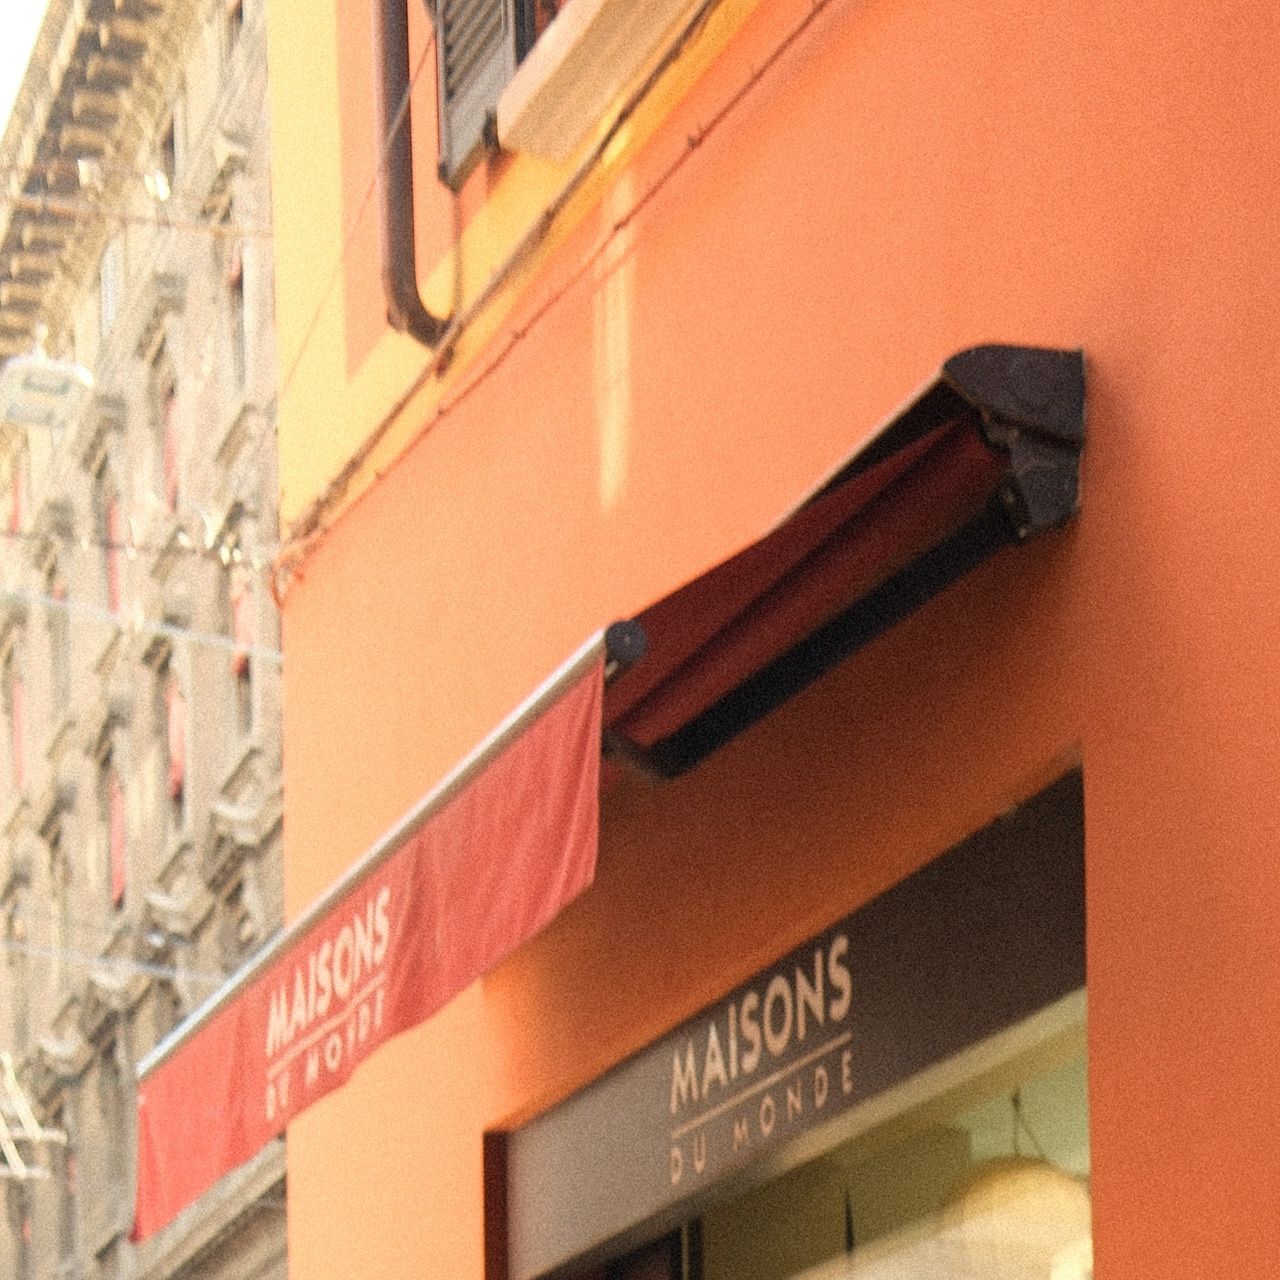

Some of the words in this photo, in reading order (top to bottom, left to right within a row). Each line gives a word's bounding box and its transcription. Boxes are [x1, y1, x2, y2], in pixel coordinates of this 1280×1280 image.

[265, 886, 391, 1057] MAISONS
[669, 934, 852, 1115] MAISONS
[670, 1132, 705, 1186] DU
[733, 1051, 853, 1152] MONDE
